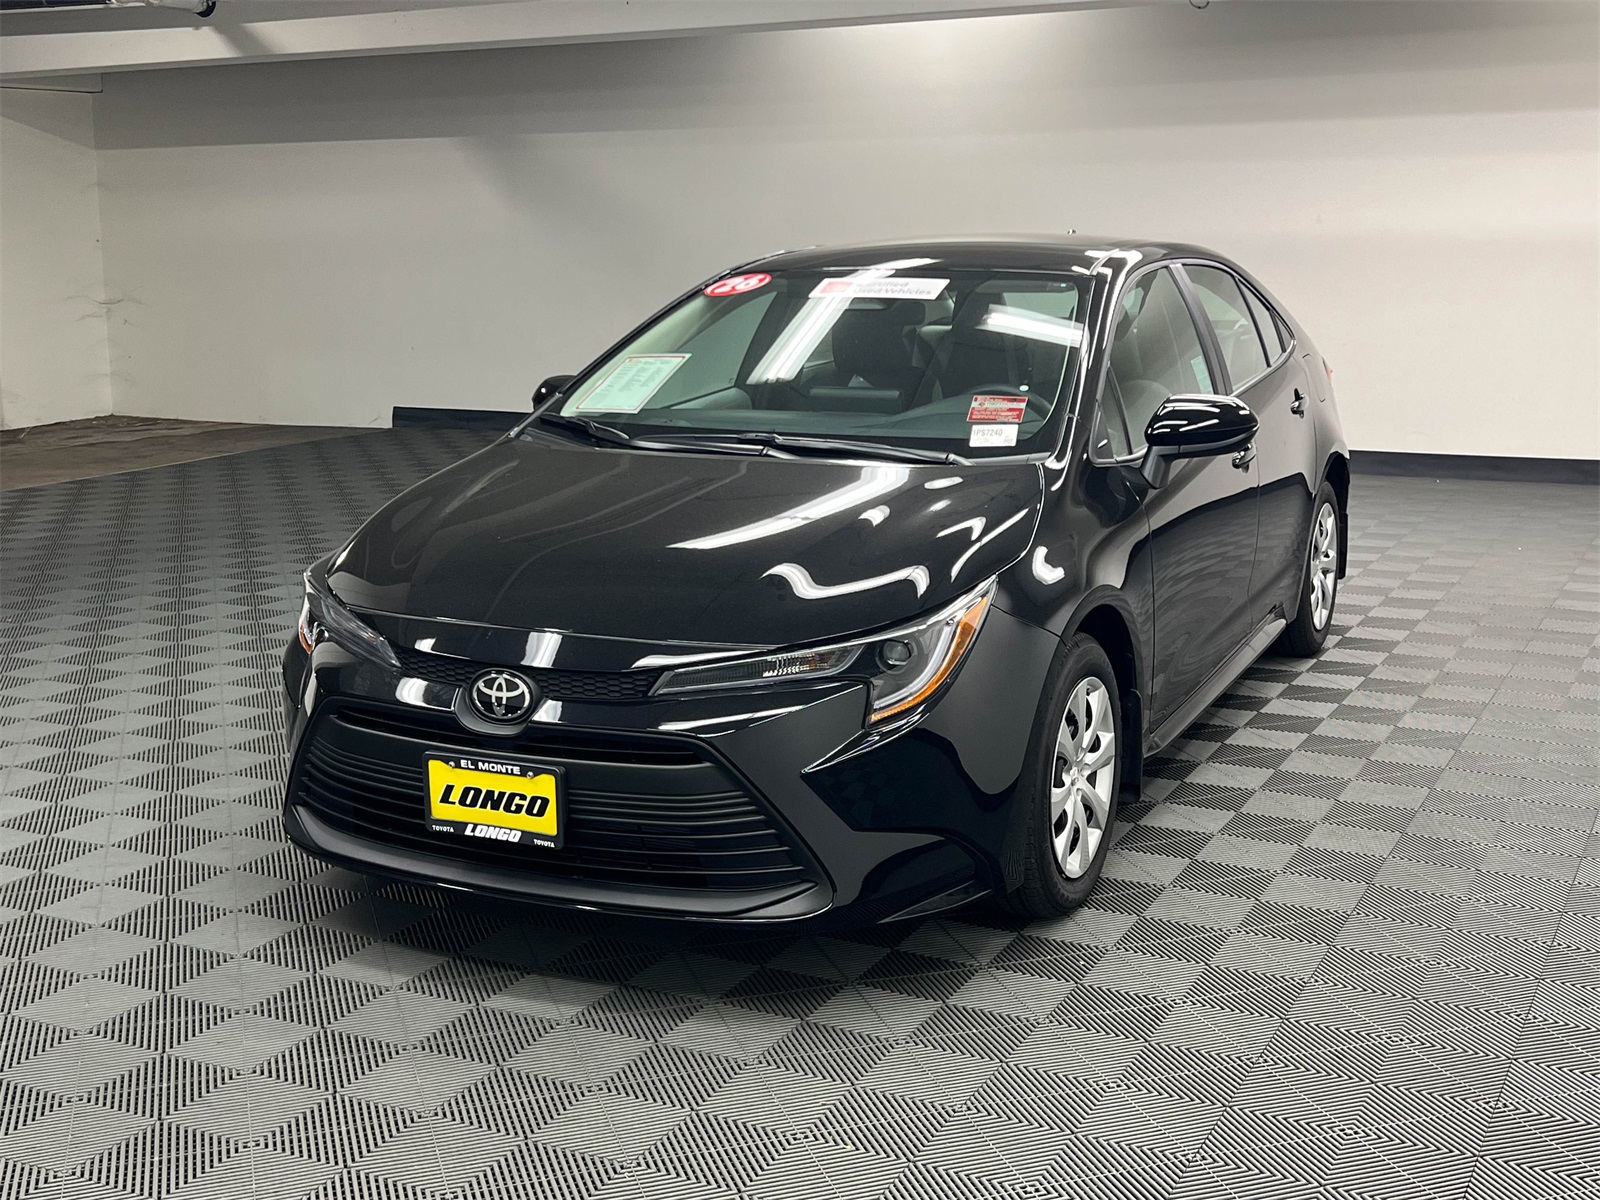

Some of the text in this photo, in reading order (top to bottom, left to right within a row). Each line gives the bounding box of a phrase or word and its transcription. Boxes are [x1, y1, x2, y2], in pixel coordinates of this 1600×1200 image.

[883, 287, 933, 296] Vehicles
[460, 759, 521, 775] EL MONTE
[438, 783, 551, 818] LONGO
[432, 824, 455, 833] TOYOTA
[464, 823, 522, 843] LONGO
[533, 838, 556, 848] TOYOTA
